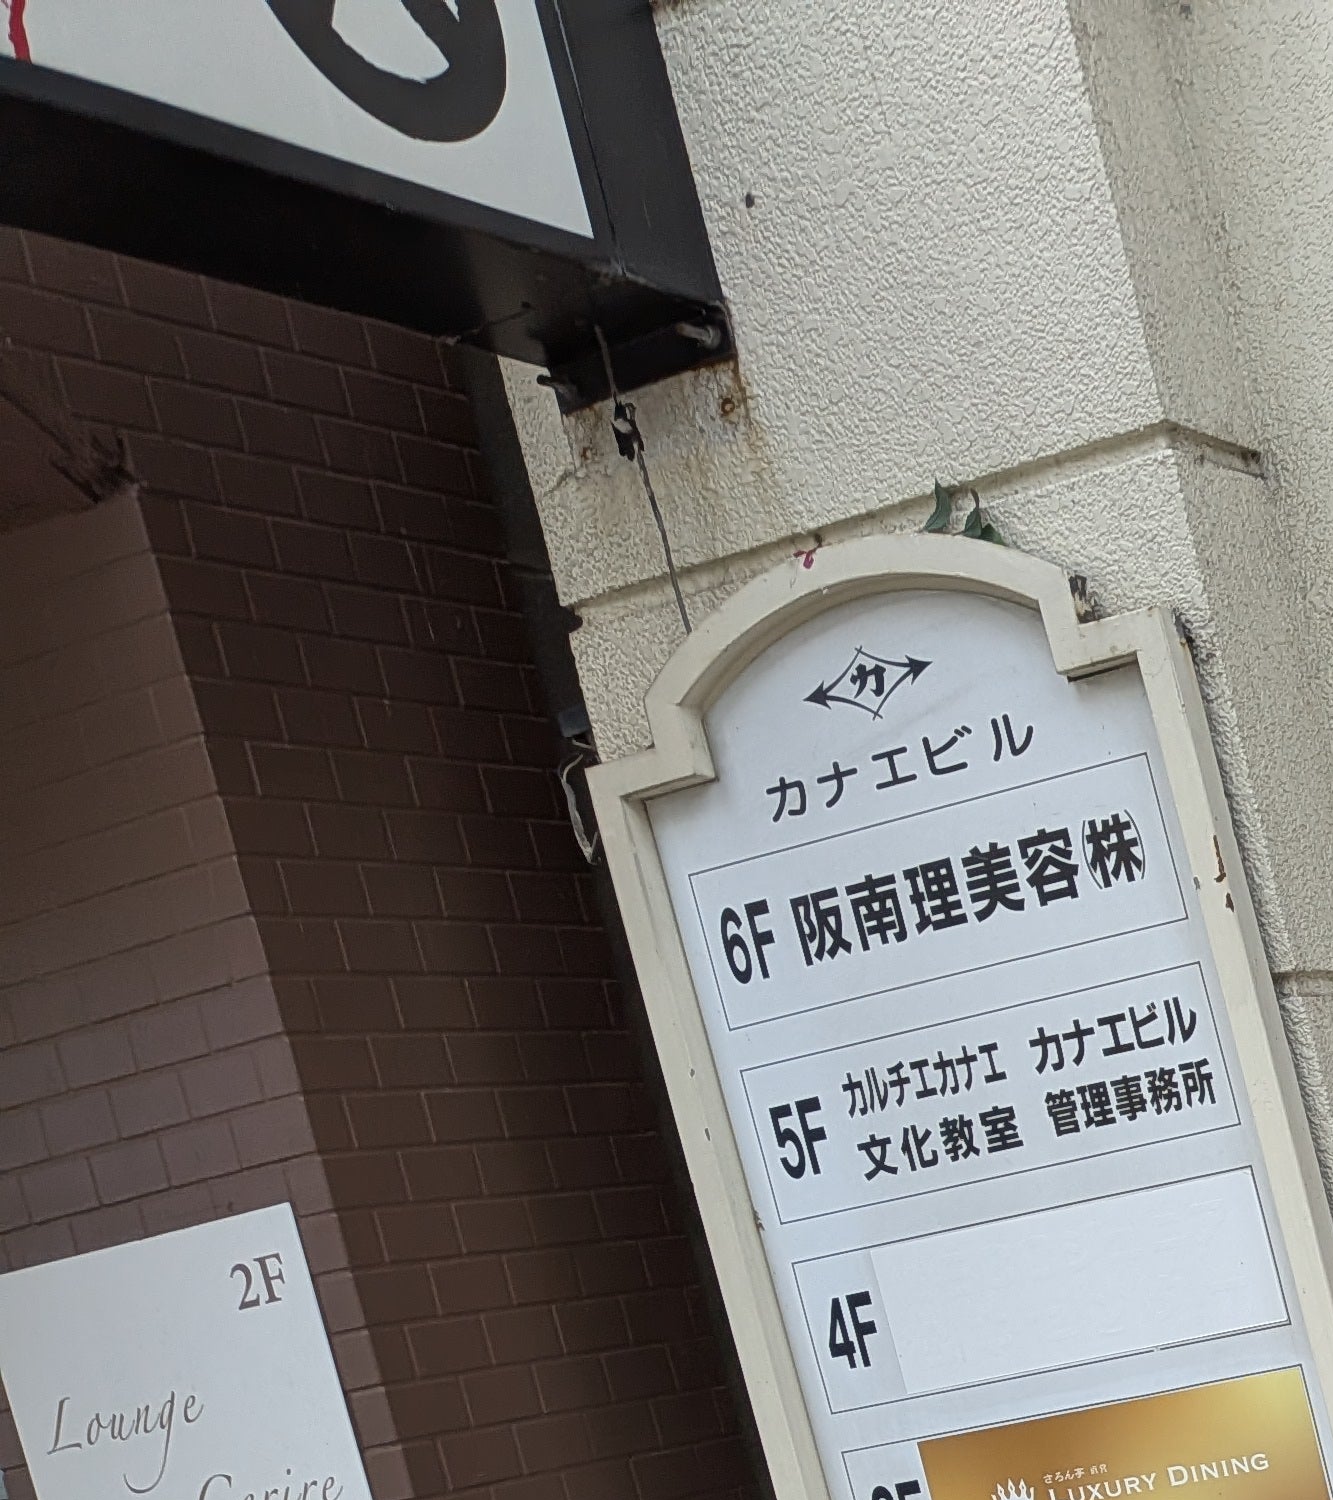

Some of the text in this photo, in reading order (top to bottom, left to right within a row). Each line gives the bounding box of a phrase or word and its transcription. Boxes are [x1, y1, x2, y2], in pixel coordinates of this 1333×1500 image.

[767, 714, 1036, 822] カナエビル
[721, 899, 774, 984] 6F
[842, 997, 1197, 1118] カルチエカナエ カナエビル
[769, 1098, 828, 1179] 5F
[857, 1060, 1220, 1182] 文化教室 管理事務所
[230, 1253, 286, 1311] 2F
[828, 1291, 877, 1370] 4F
[47, 1390, 204, 1494] Lounge
